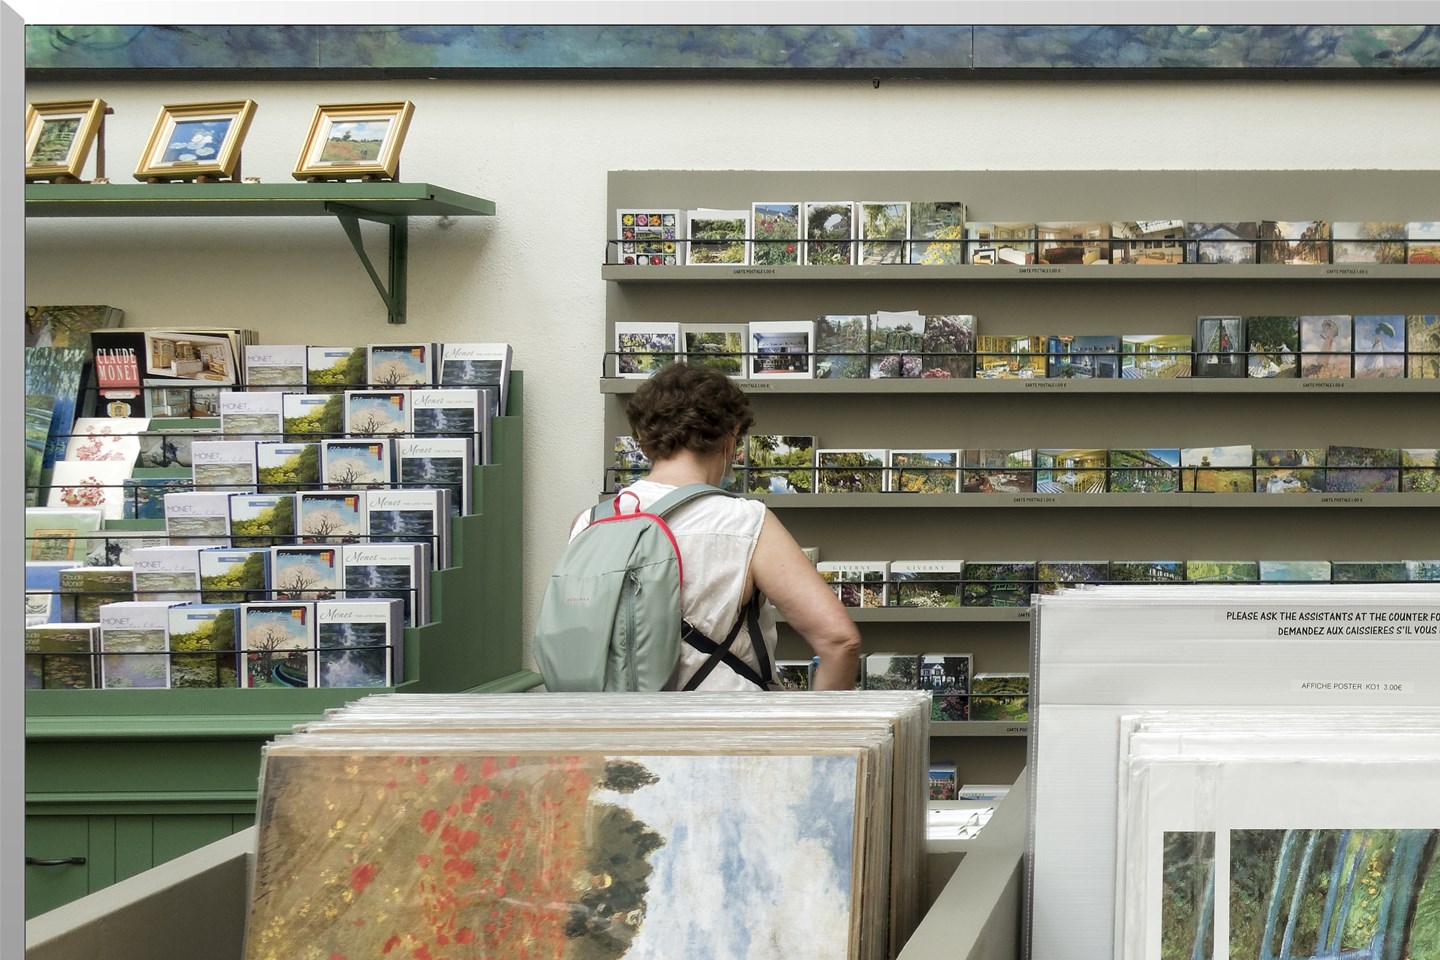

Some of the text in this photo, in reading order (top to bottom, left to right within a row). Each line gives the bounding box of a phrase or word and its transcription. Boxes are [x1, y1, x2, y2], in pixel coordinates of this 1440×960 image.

[96, 348, 137, 364] CLAUDE
[445, 348, 474, 357] Monet
[98, 364, 138, 381] MONET
[414, 395, 444, 405] Monet
[402, 445, 432, 455] Monet
[370, 497, 400, 507] Monet
[346, 552, 378, 562] Monet
[320, 608, 352, 620] Monet
[1226, 611, 1259, 621] PLEASE
[1260, 611, 1278, 621] ASK
[1279, 611, 1297, 621] THE
[1299, 612, 1353, 621] ASSISTANTS
[1355, 612, 1368, 621] AT
[1369, 612, 1387, 621] THE
[1388, 612, 1429, 622] COUNTER
[1278, 626, 1325, 636] DEMANDEZ
[1326, 626, 1344, 635] AUX
[1345, 625, 1394, 635] CAISSIERES
[1396, 625, 1412, 635] S'IL
[1414, 625, 1438, 635] VOUS
[1301, 682, 1332, 690] AFFICHE
